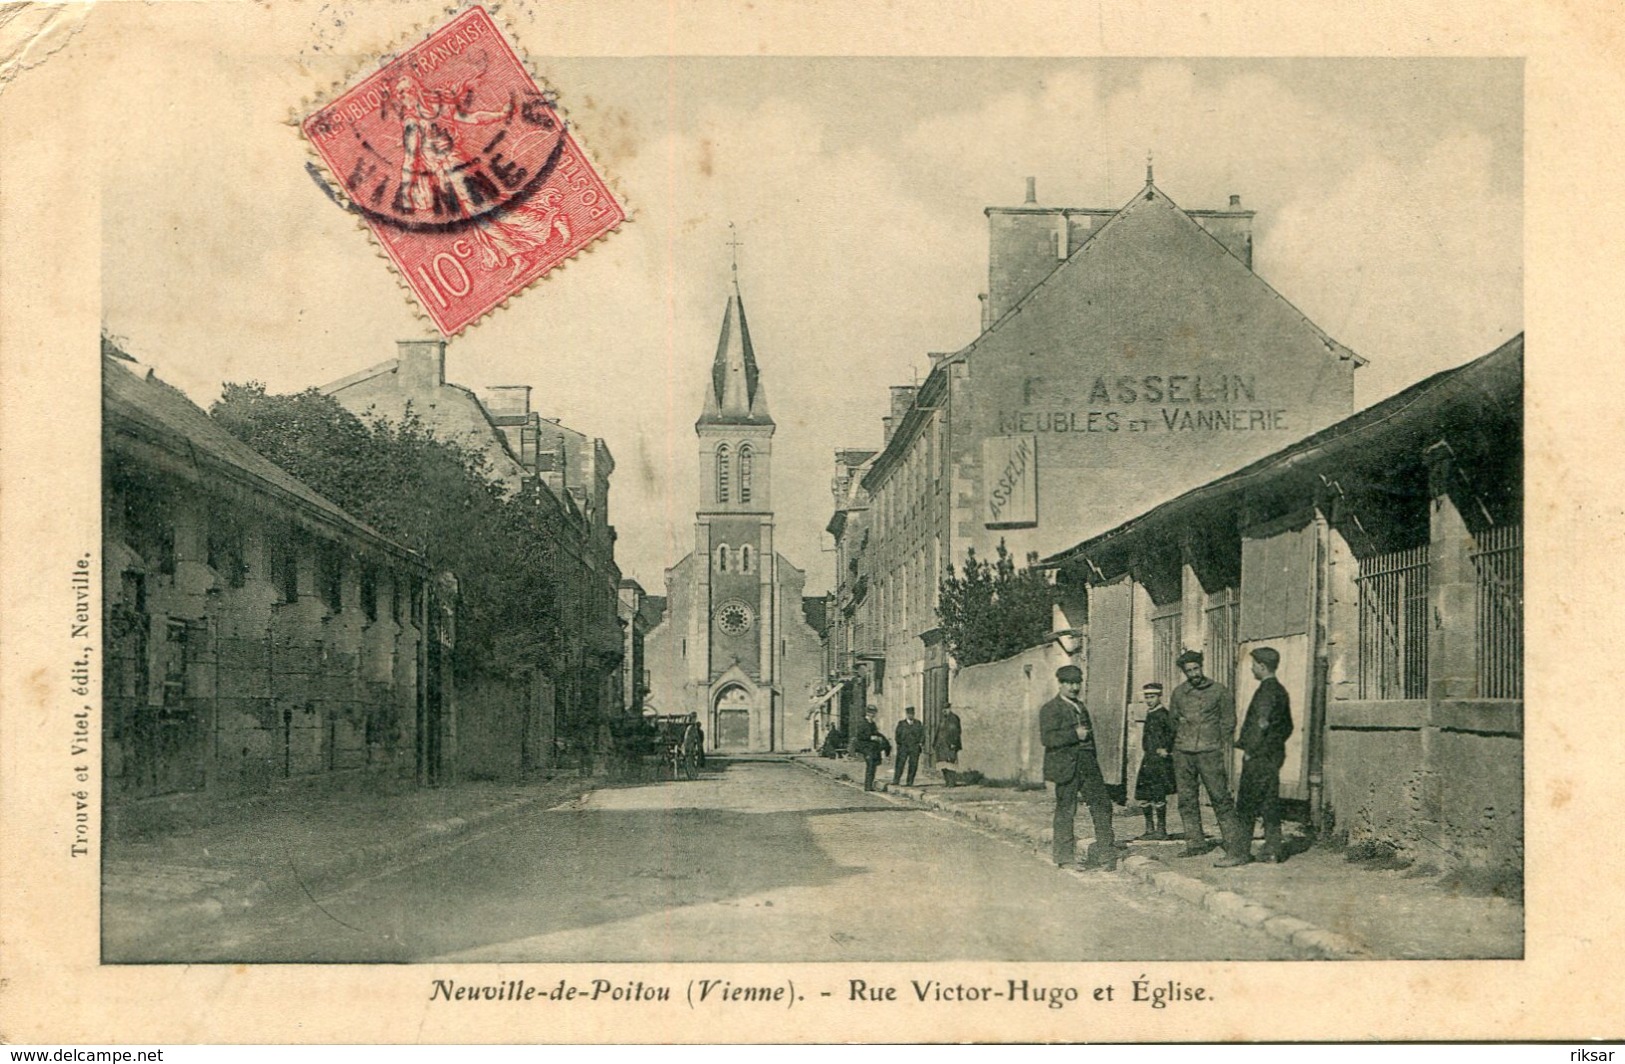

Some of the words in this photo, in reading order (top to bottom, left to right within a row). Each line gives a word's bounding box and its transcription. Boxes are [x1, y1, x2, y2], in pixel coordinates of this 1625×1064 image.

[1088, 374, 1257, 404] ASSELIN
[999, 410, 1120, 432] MEUBLES
[1161, 408, 1290, 431] VANNERIE
[989, 437, 1032, 521] ASSELIN
[72, 553, 90, 638] Neuville.
[72, 647, 93, 695] édit.,
[71, 706, 92, 755] Vitet,
[74, 766, 88, 782] et
[71, 791, 88, 857] Trouvé
[429, 980, 669, 1001] Neuville-de-Poitou
[688, 980, 804, 1008] (Vienne).
[849, 980, 896, 1001] Rue
[911, 980, 1078, 1009] Victor-Hugo
[1093, 985, 1114, 1001] et
[1132, 974, 1213, 1009] Église.
